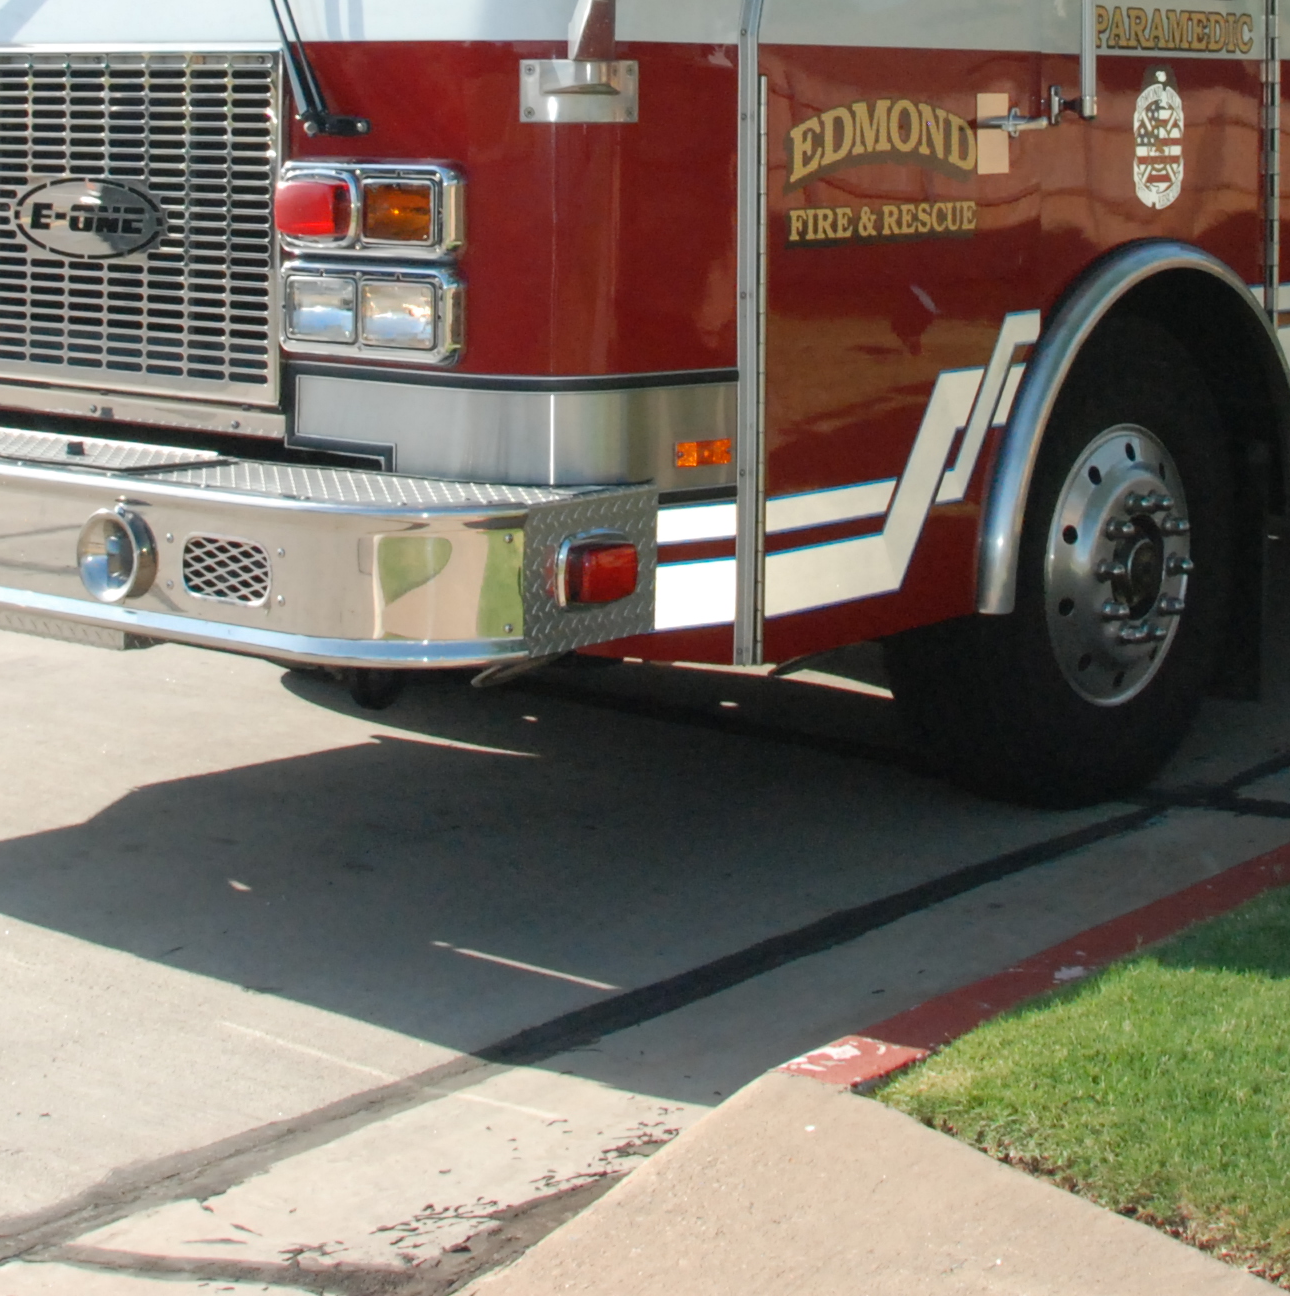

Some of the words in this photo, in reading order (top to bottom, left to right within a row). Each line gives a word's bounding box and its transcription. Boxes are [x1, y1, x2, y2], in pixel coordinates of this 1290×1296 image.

[1095, 4, 1254, 54] PARAMEDIC
[789, 99, 977, 184] EDMOND
[30, 202, 145, 235] E-ONE
[789, 207, 853, 241] FIRE
[858, 206, 878, 237] &
[882, 201, 977, 235] RESCUE
